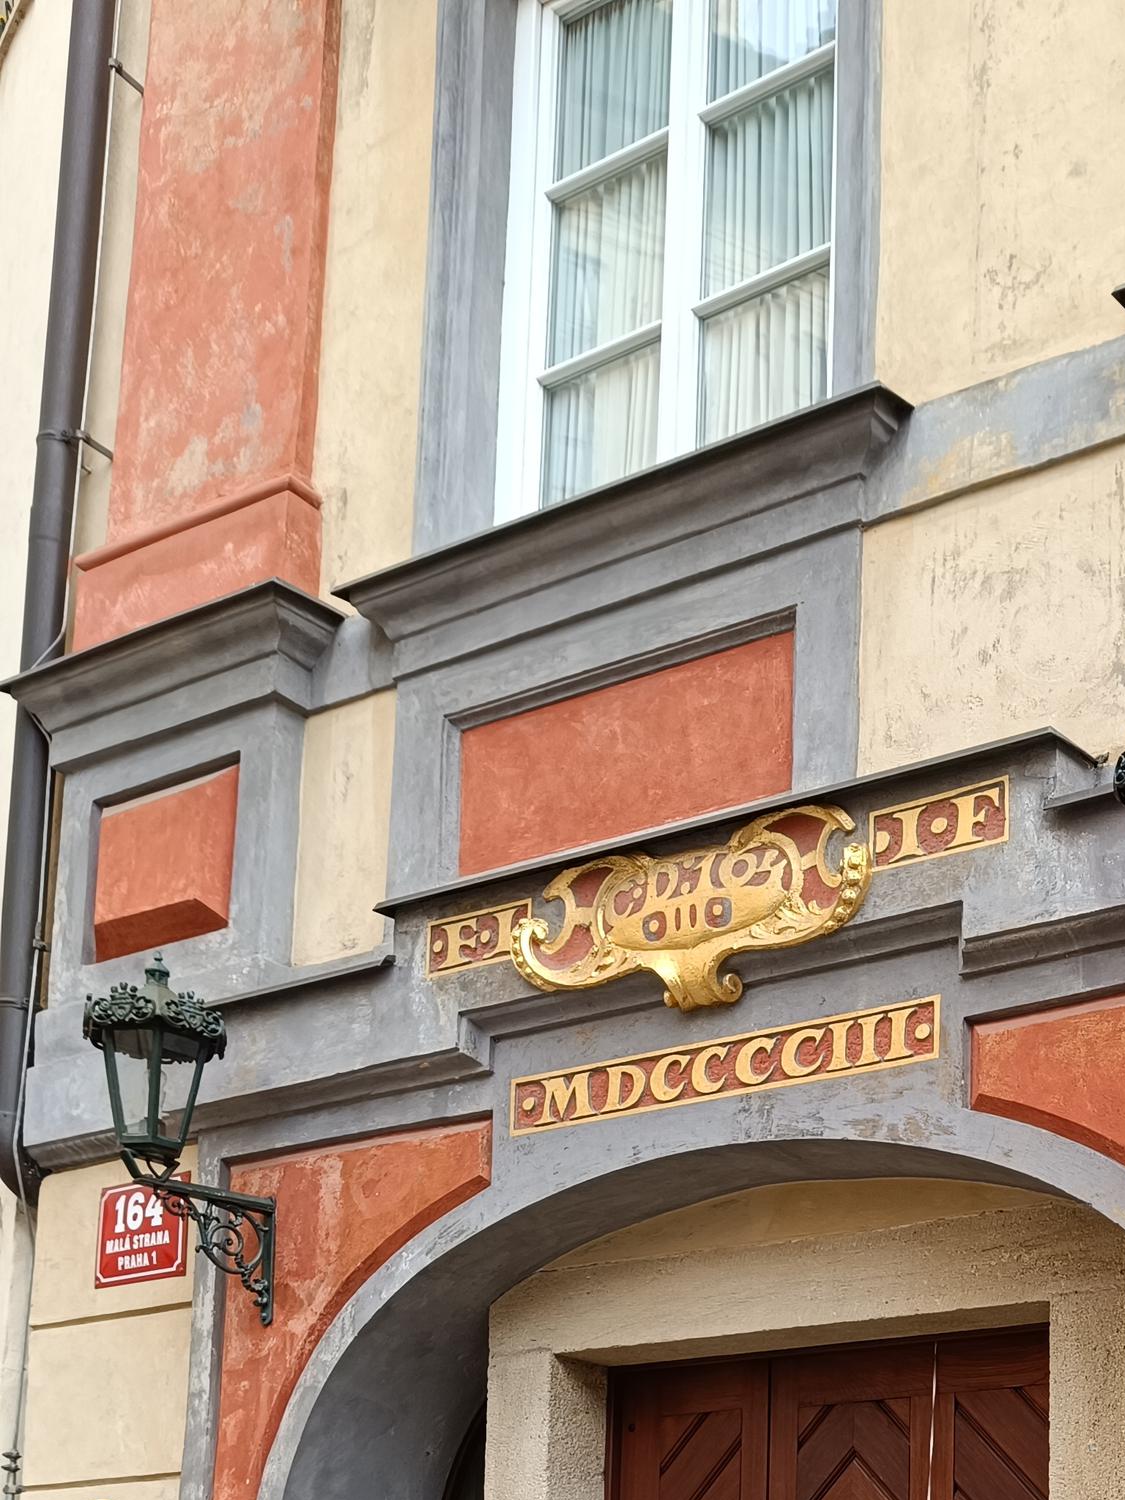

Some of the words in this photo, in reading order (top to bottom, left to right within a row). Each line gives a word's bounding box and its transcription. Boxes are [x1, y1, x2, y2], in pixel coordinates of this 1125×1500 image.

[114, 1191, 164, 1233] 164
[105, 1234, 131, 1254] MALÁ
[132, 1230, 170, 1250] STRANA
[118, 1252, 150, 1271] PRAHA
[151, 1251, 158, 1265] 1
